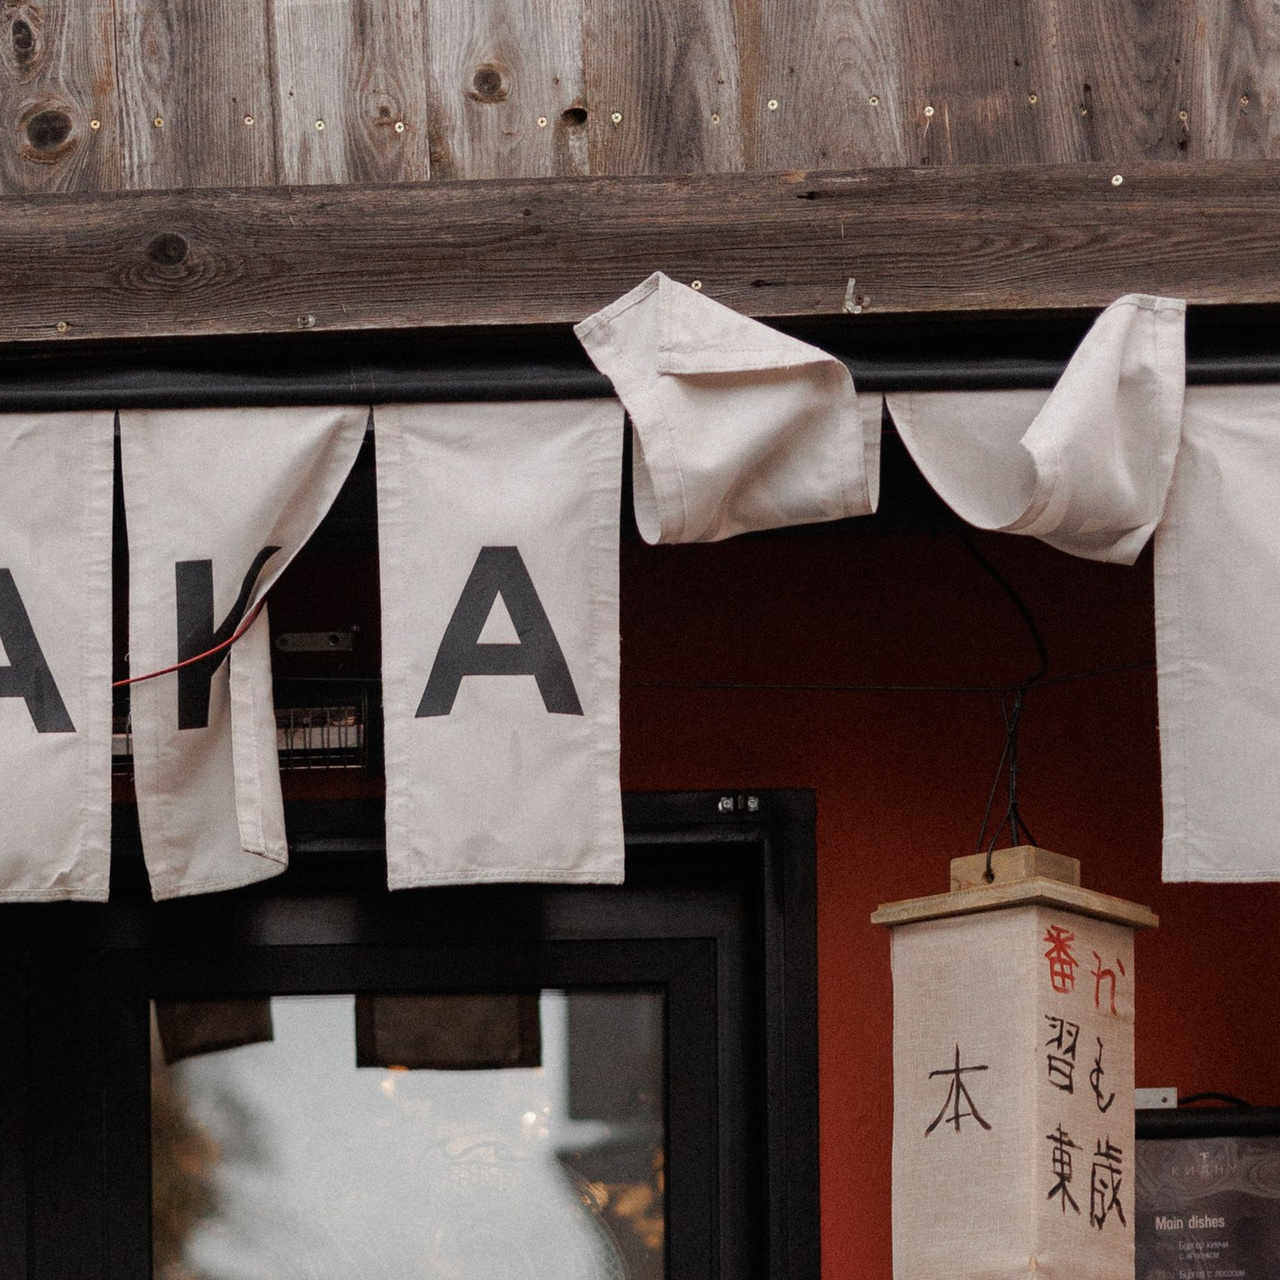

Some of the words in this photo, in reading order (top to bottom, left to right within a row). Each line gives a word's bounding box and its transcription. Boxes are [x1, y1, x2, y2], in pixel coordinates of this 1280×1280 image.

[925, 1042, 992, 1138] 本
[1155, 1216, 1184, 1230] Main
[1188, 1214, 1226, 1229] dishes
